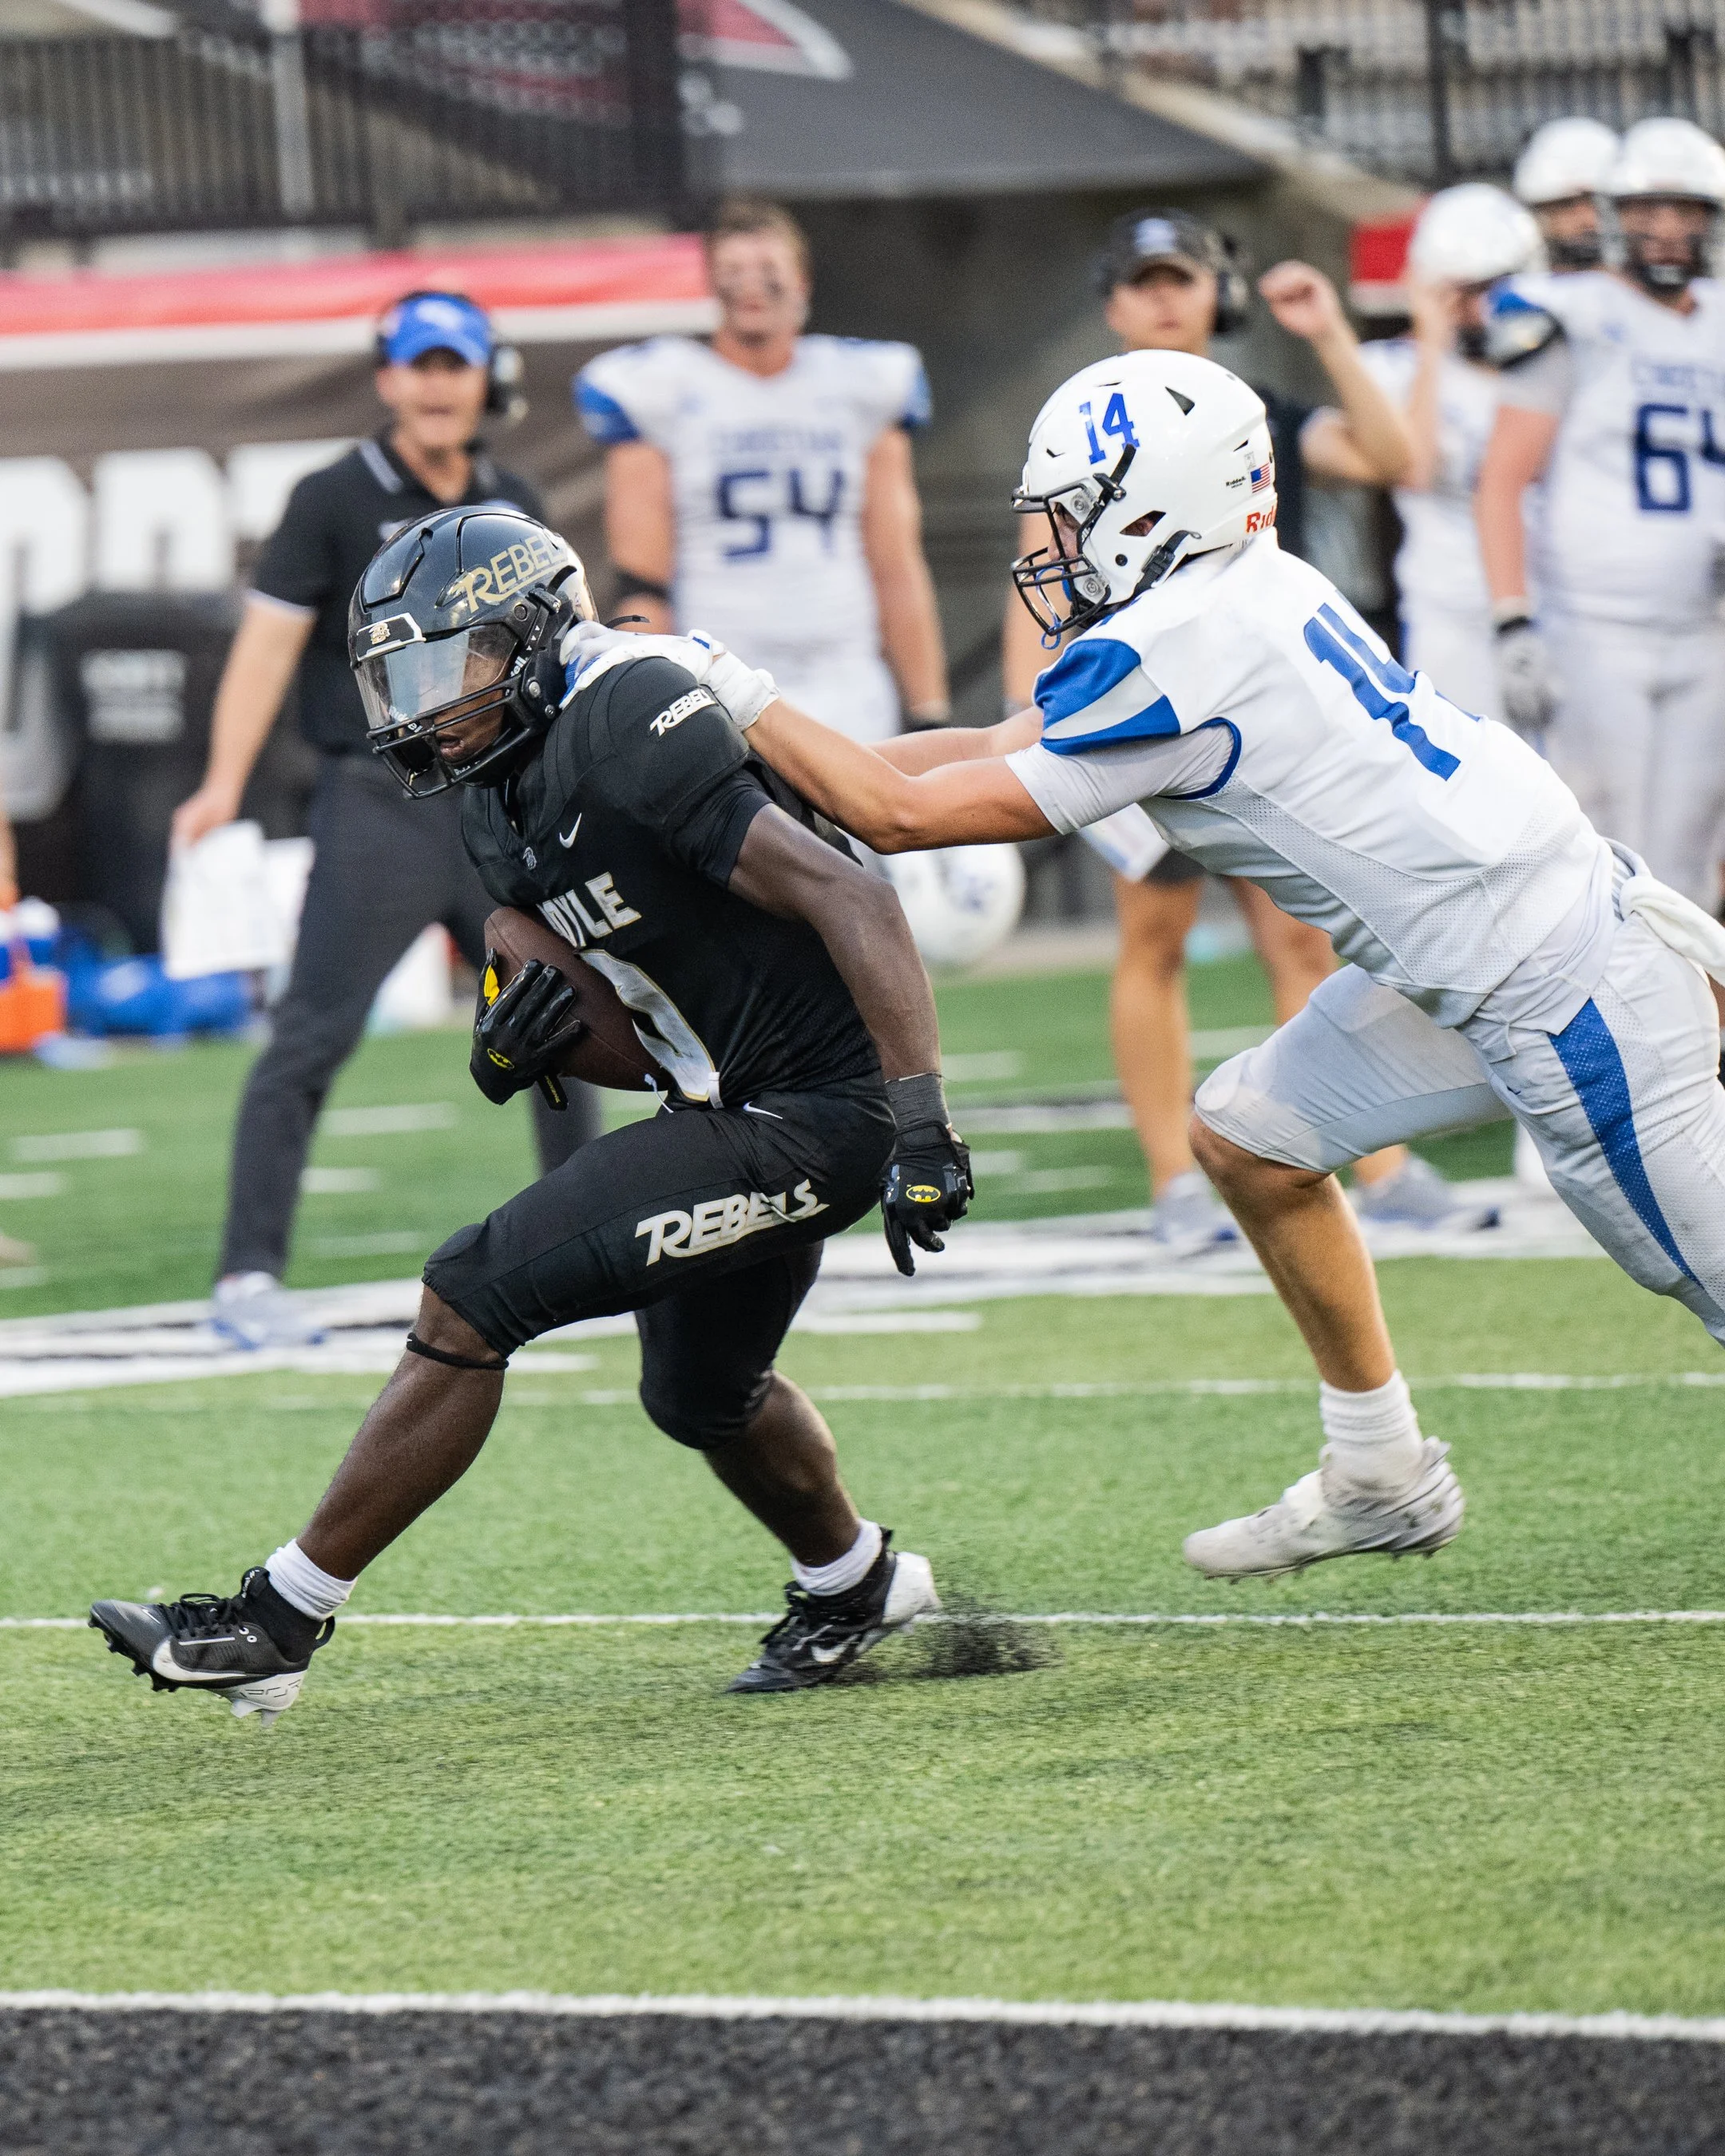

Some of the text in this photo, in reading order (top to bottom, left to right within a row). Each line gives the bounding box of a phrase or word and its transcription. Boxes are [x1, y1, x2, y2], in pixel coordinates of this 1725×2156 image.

[1079, 393, 1140, 465] 14
[716, 467, 849, 561] 54
[536, 871, 642, 949] OYLE
[635, 1178, 830, 1266] REBELS
